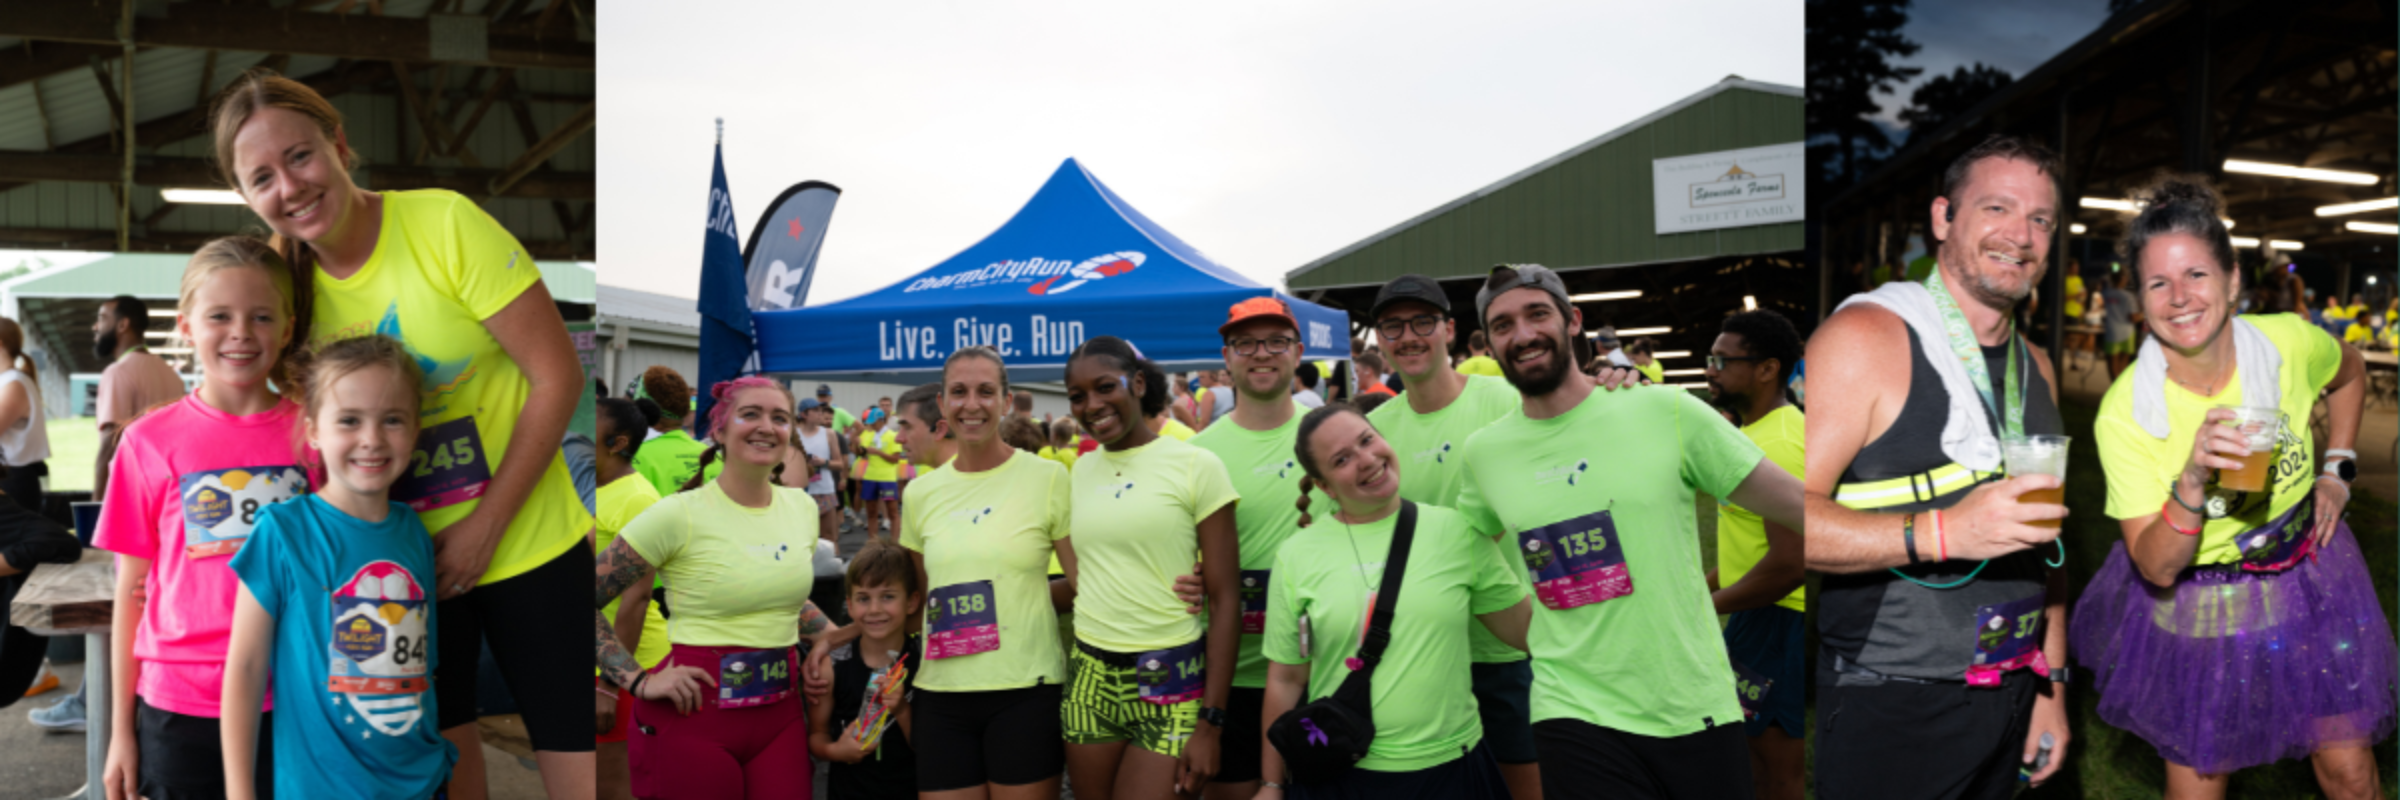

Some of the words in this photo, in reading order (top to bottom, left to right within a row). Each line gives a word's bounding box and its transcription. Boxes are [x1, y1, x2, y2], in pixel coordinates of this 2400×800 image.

[1745, 203, 1795, 219] FAMILY
[879, 319, 944, 361] Live.
[954, 316, 1021, 357] Give.
[1031, 314, 1085, 357] Run
[411, 435, 475, 478] 245
[1557, 527, 1607, 559] 135
[947, 593, 987, 616] 138
[338, 631, 383, 644] TWILIGHT
[392, 634, 428, 665] 84
[759, 659, 788, 683] 142
[1733, 671, 1762, 701] 46
